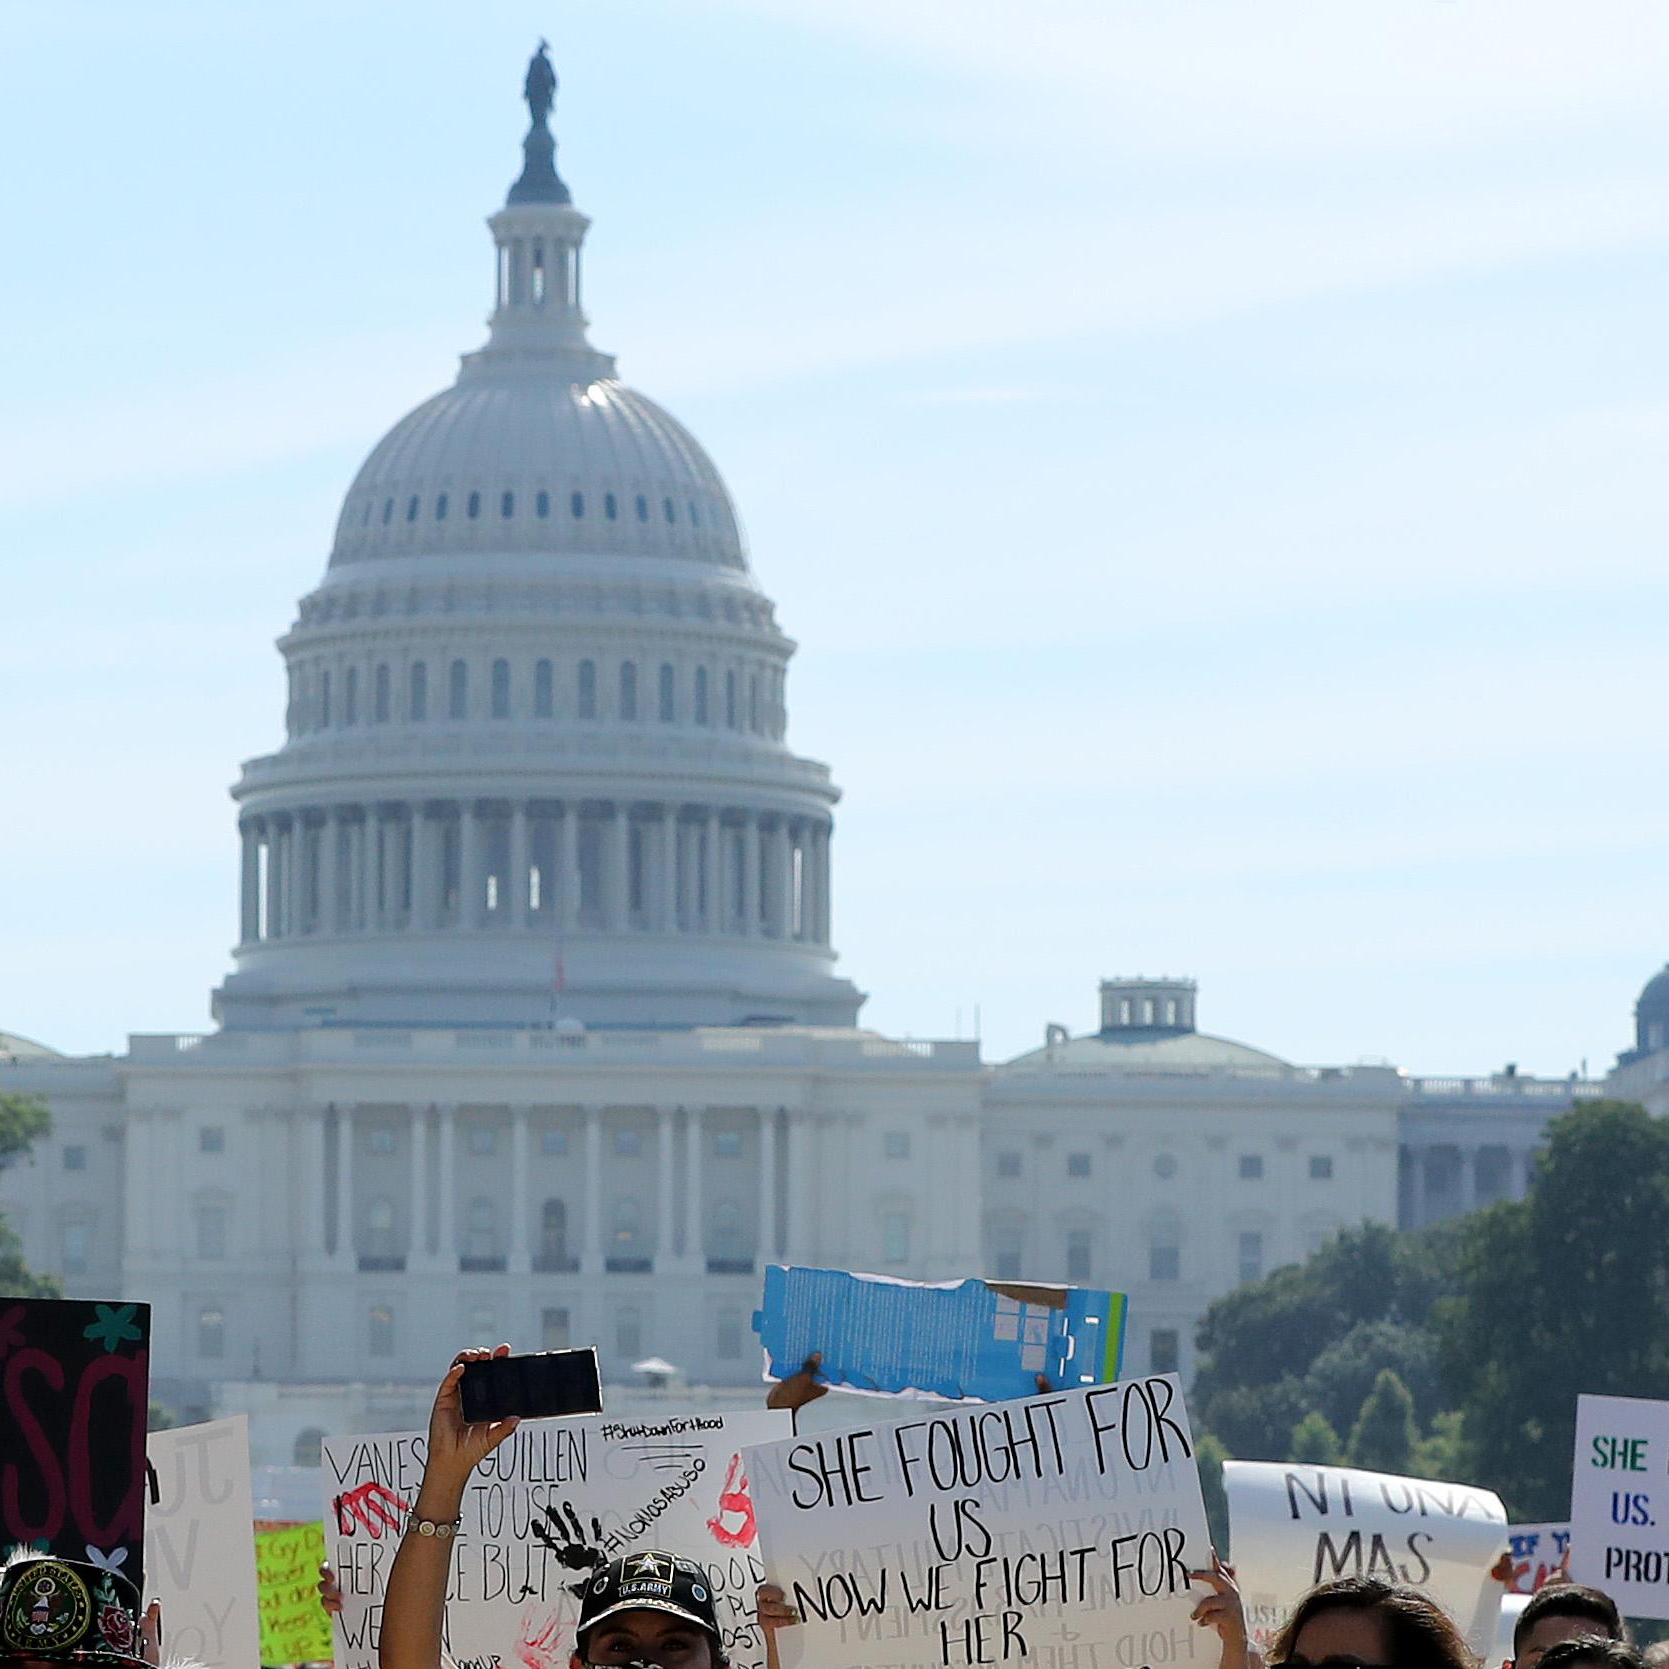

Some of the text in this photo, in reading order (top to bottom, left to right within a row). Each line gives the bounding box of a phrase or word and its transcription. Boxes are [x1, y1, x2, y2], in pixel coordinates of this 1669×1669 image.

[325, 1428, 588, 1490] VANES GUILLEN
[788, 1430, 883, 1509] SHE
[896, 1399, 1067, 1497] FOUGHT
[1085, 1378, 1191, 1475] FOR
[1592, 1436, 1649, 1470] SHE
[1285, 1472, 1354, 1519] NI
[1612, 1492, 1655, 1526] US.
[930, 1499, 992, 1562] US
[1314, 1531, 1433, 1584] MAS
[484, 1544, 547, 1604] BUT
[793, 1568, 887, 1623] NOW
[901, 1563, 955, 1613] WE
[975, 1548, 1097, 1609] FIGHT
[1112, 1528, 1191, 1599] FOR
[940, 1611, 1028, 1665] HER
